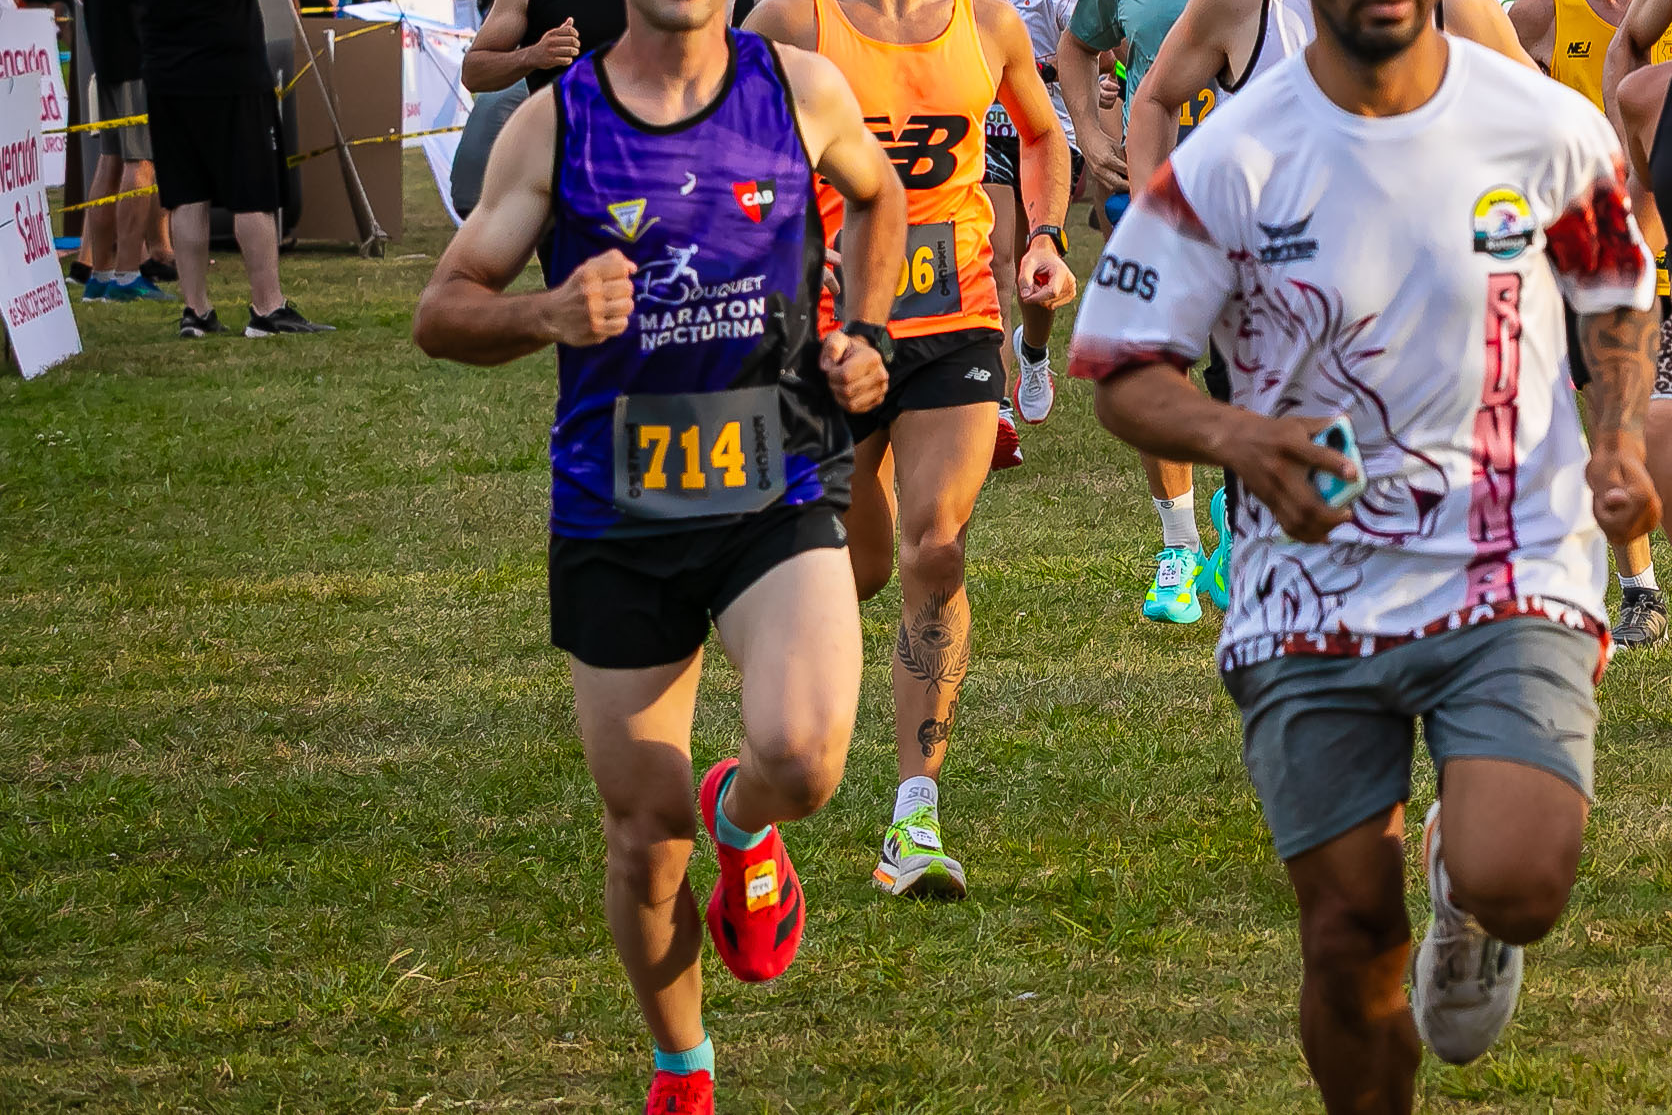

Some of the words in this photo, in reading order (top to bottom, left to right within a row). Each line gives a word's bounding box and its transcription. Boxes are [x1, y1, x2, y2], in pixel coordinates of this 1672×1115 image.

[741, 190, 774, 206] CAB
[15, 191, 50, 264] Salud
[937, 240, 951, 297] EXACTO
[638, 297, 766, 330] MARATON
[640, 317, 765, 351] NOCTURNA
[638, 421, 747, 489] 714
